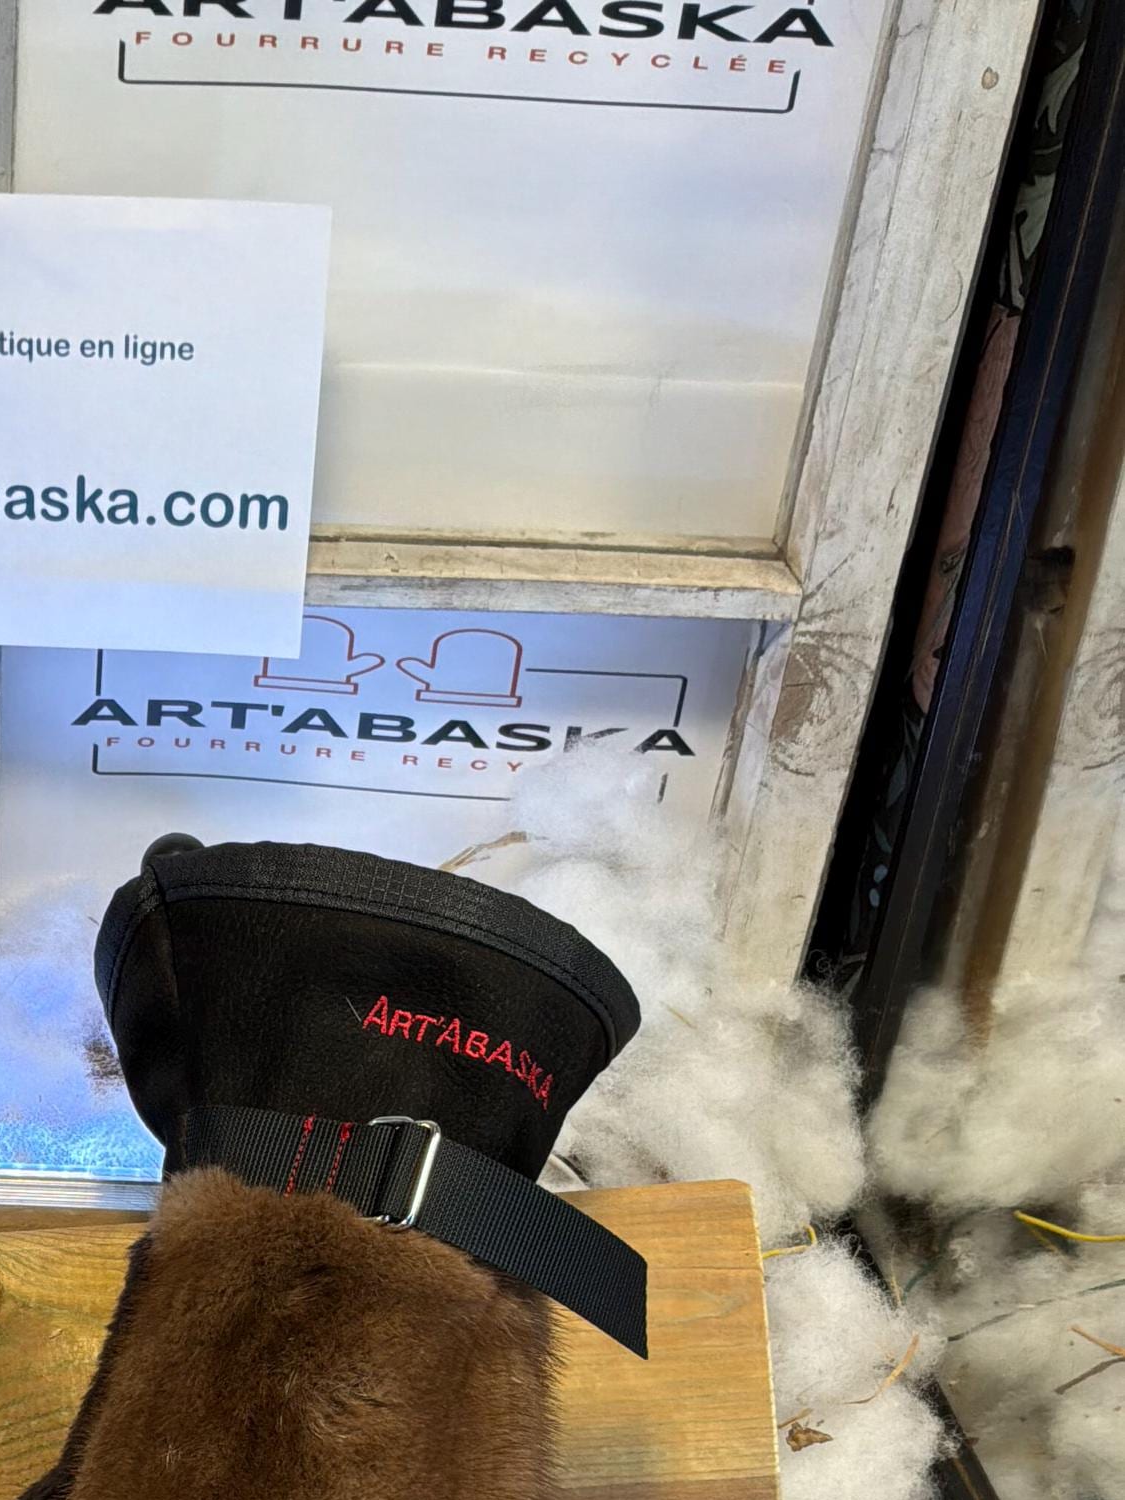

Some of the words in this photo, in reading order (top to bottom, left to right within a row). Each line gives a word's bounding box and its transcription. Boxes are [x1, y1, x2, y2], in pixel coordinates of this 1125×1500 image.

[135, 31, 445, 57] FOURRURE
[487, 46, 787, 74] RECYCLÉE
[79, 338, 114, 359] en
[123, 333, 195, 365] ligne
[106, 736, 366, 761] FOURRURE
[402, 754, 523, 773] RECY
